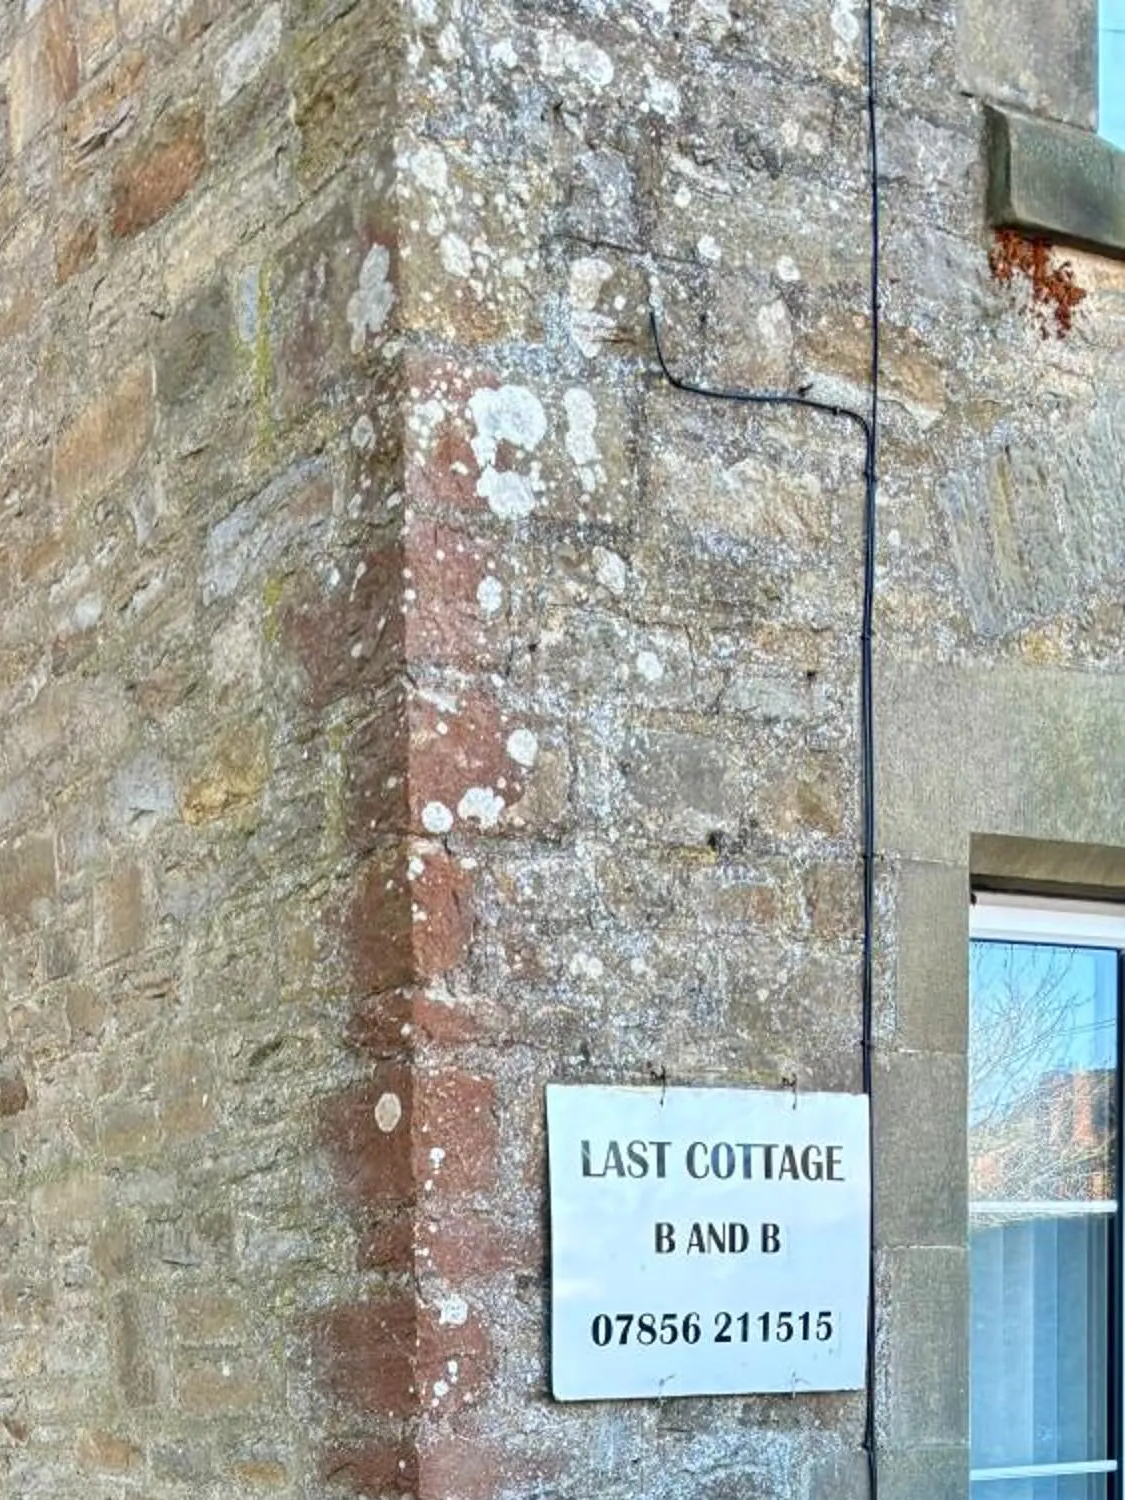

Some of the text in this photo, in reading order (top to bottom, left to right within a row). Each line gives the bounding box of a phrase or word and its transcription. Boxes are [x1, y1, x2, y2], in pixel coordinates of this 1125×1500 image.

[581, 1140, 845, 1181] LAST COTTAGE
[654, 1222, 781, 1254] B AND B
[591, 1311, 833, 1346] 07856 211515
